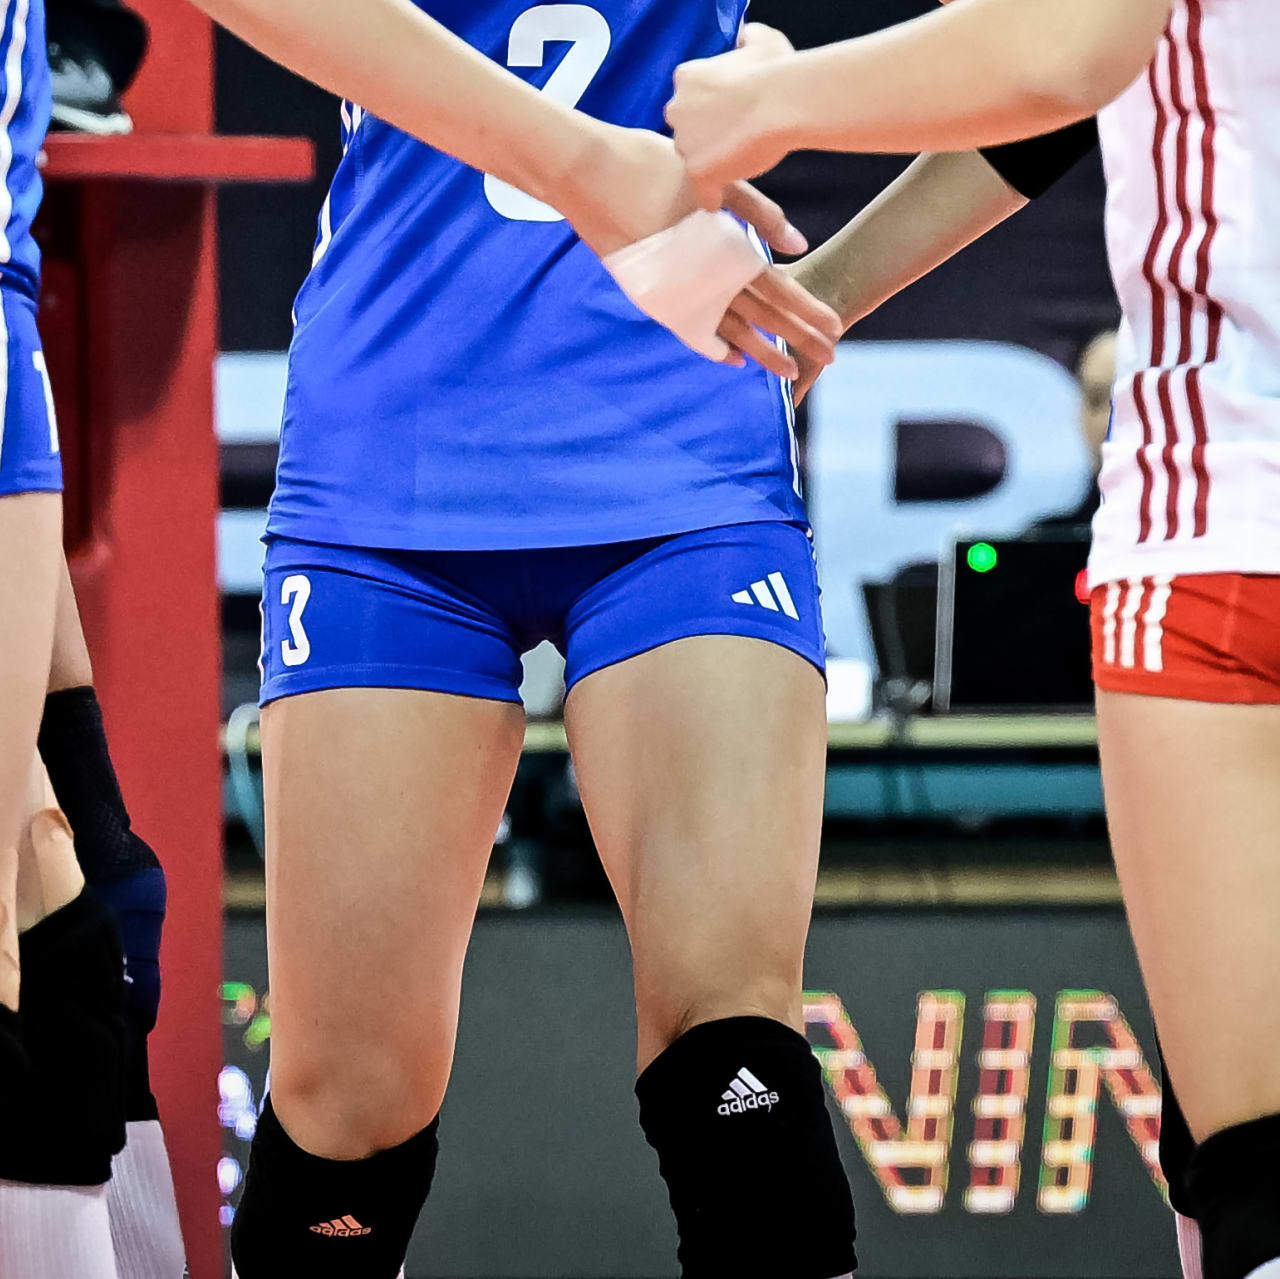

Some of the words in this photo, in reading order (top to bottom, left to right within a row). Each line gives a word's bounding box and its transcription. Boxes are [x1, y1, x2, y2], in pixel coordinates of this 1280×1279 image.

[281, 574, 311, 667] 3
[717, 1091, 780, 1116] adidas
[309, 1224, 372, 1237] adidas
